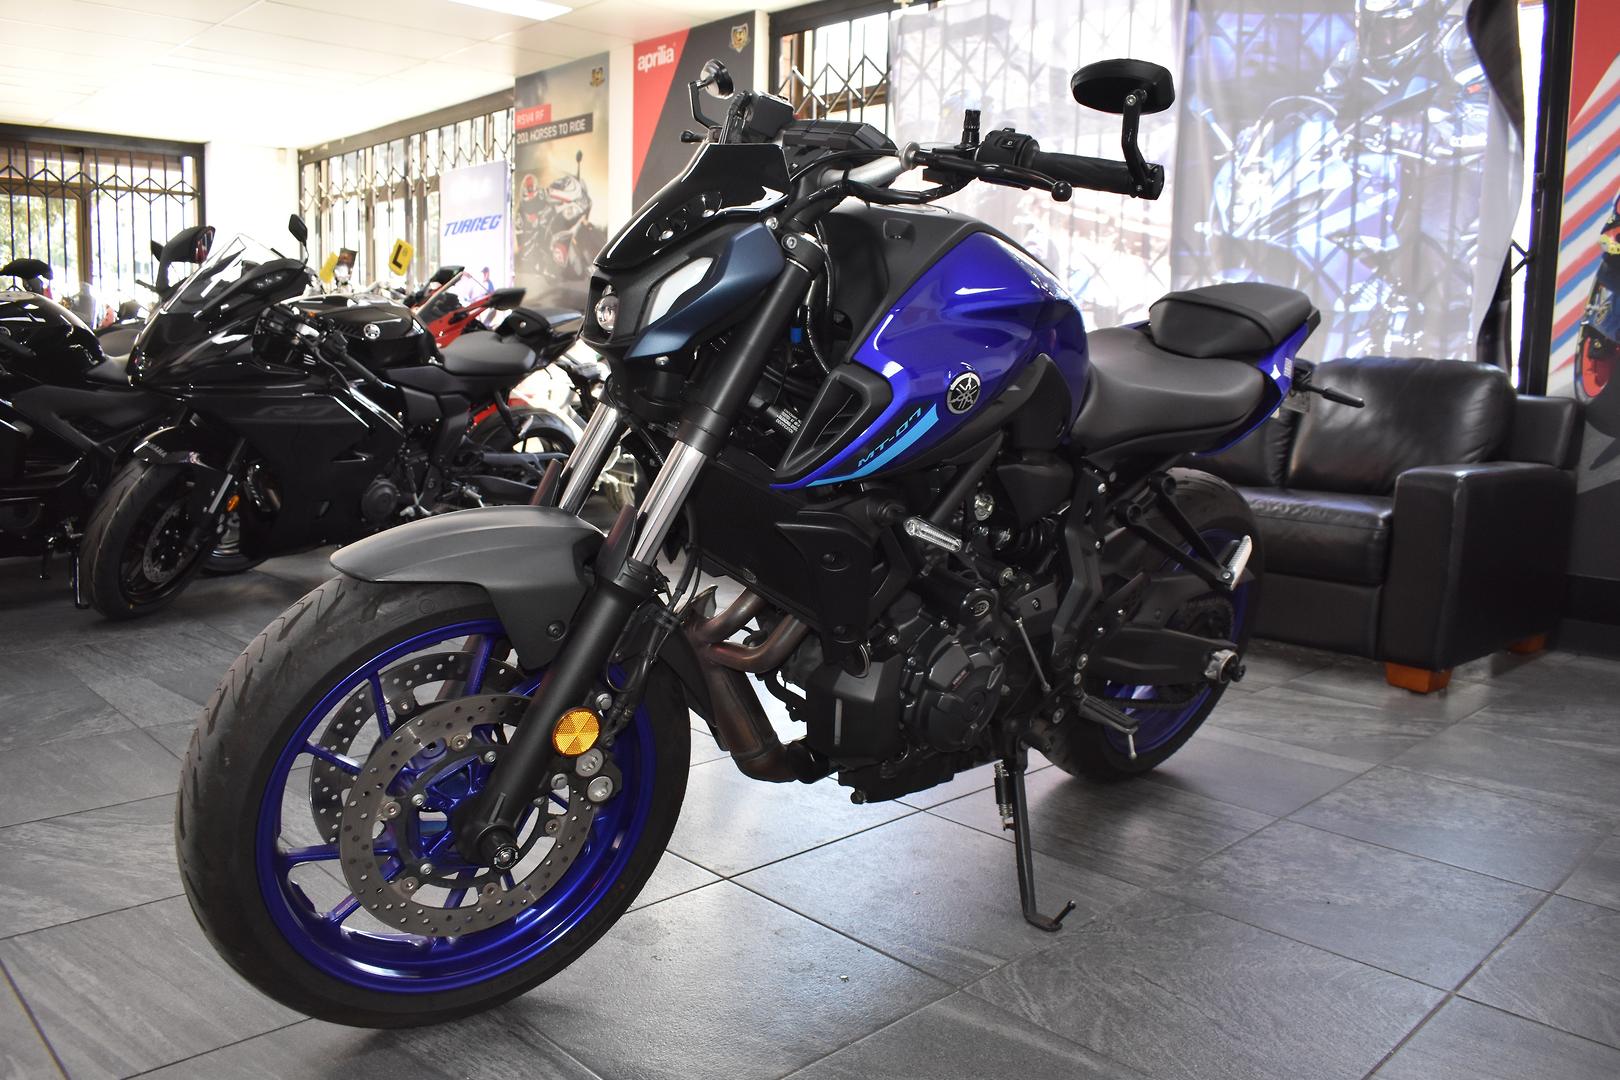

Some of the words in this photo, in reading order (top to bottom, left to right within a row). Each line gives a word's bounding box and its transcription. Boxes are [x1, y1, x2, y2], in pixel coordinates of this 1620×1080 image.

[637, 44, 675, 73] aprilia
[530, 125, 558, 140] HORSES
[559, 122, 569, 135] TO
[569, 118, 587, 132] RIDE
[391, 244, 403, 270] L
[857, 407, 922, 468] MT-07
